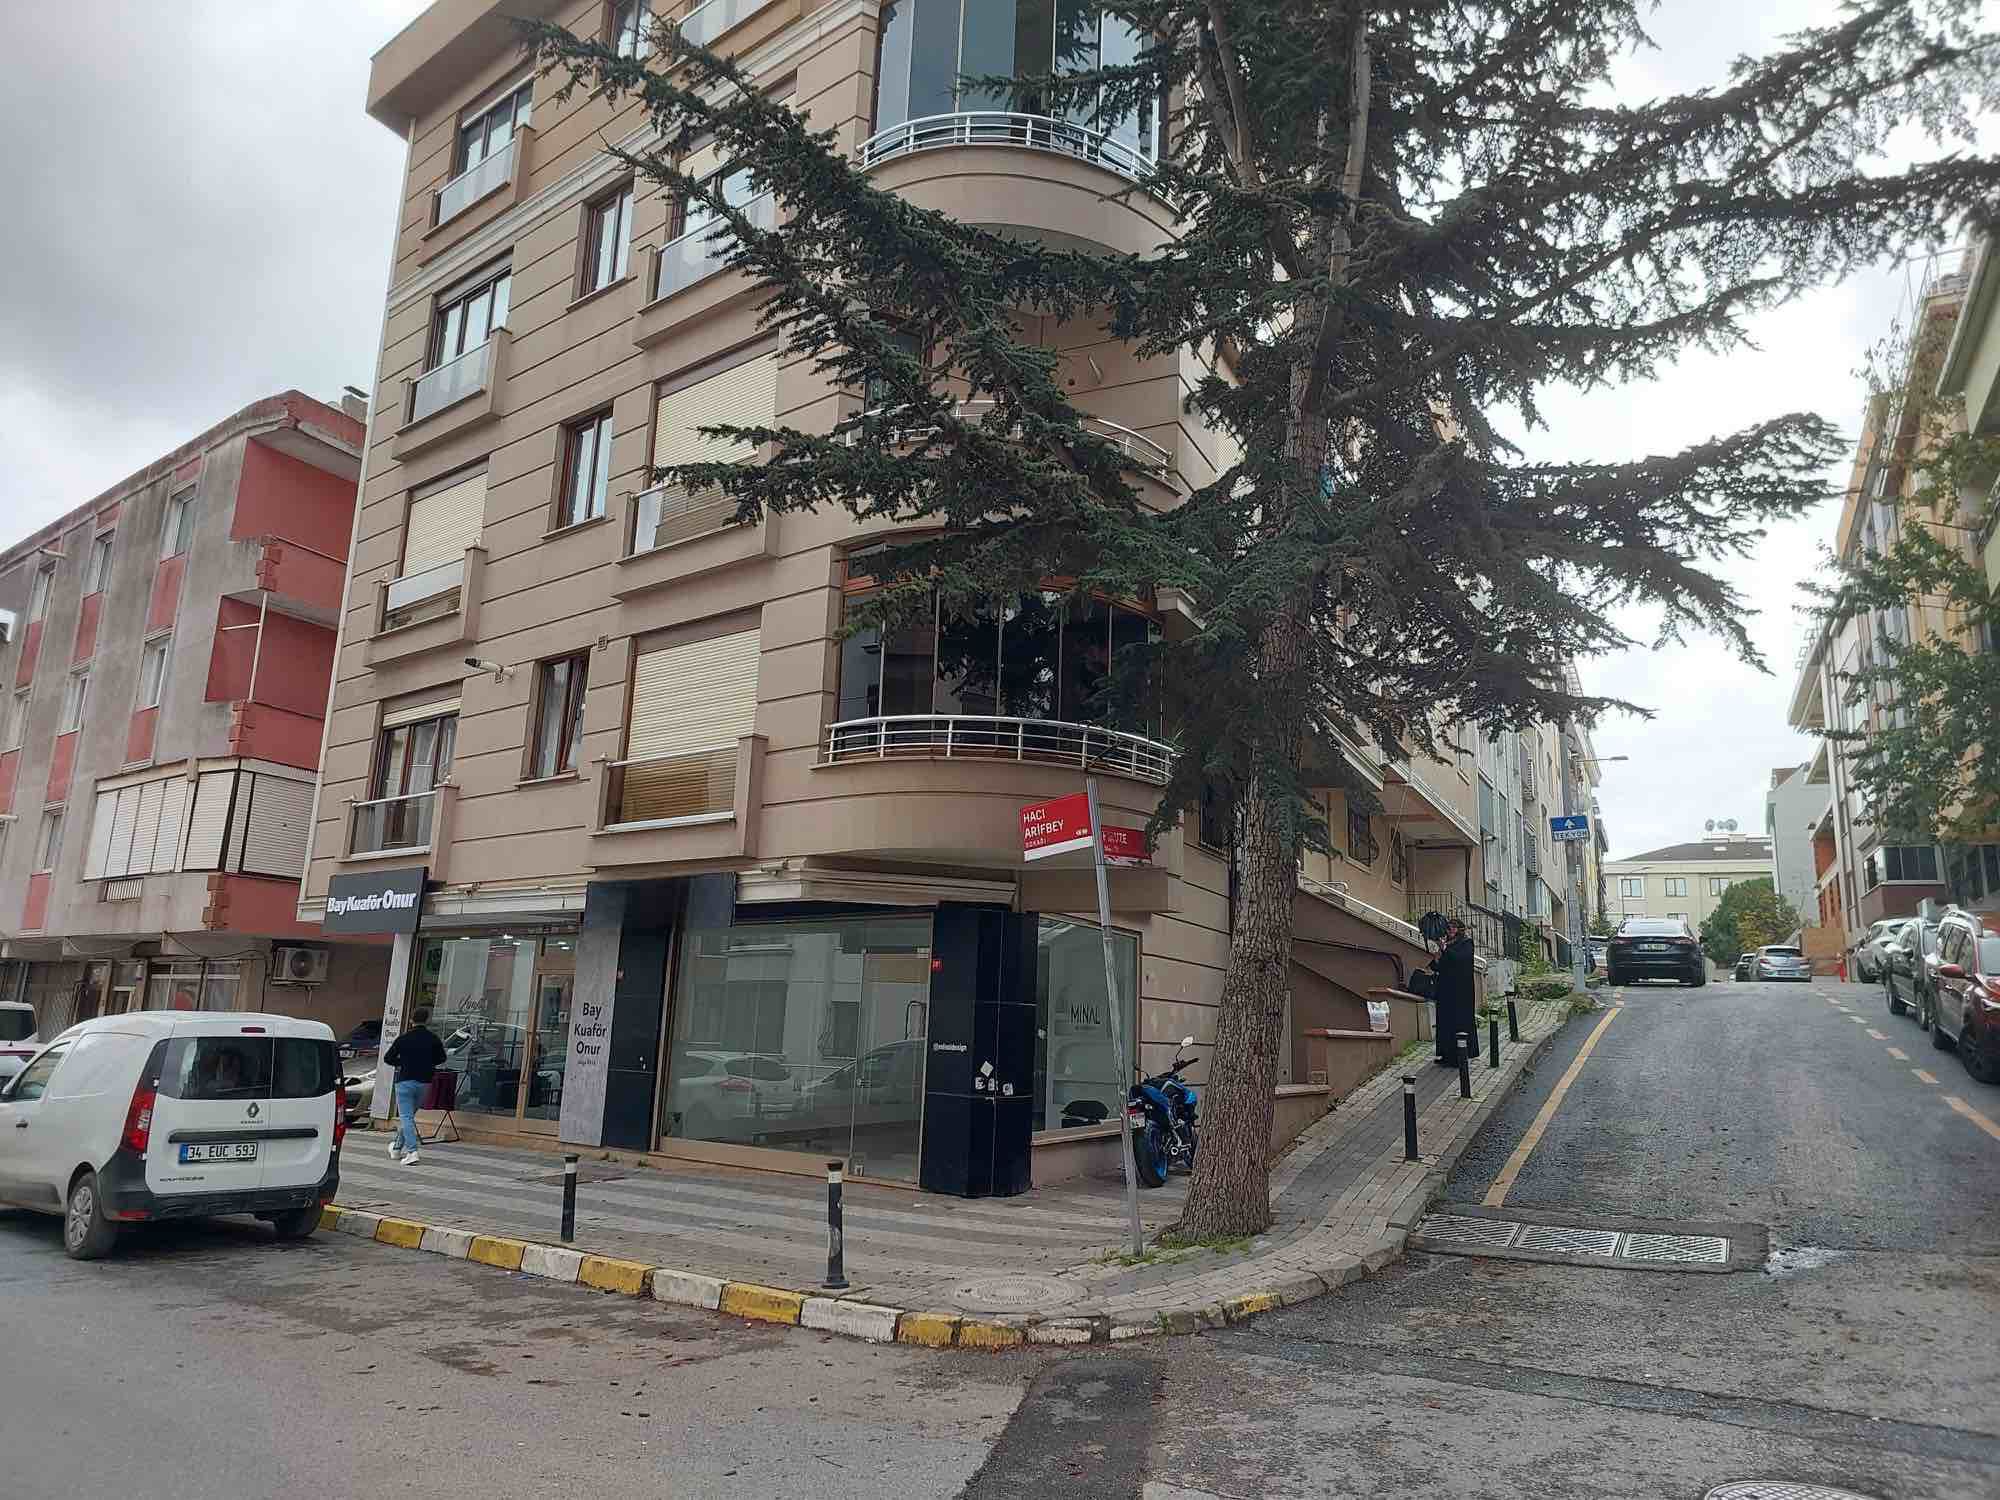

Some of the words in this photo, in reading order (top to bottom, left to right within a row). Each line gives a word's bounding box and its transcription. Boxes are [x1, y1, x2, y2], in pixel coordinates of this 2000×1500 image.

[1023, 808, 1046, 823] HACI
[1024, 819, 1064, 839] ARİFBEY
[583, 1002, 602, 1020] Bay
[575, 1022, 607, 1037] Kuaför
[576, 1041, 601, 1055] Onur
[189, 1146, 201, 1158] 34
[208, 1145, 229, 1157] EUC
